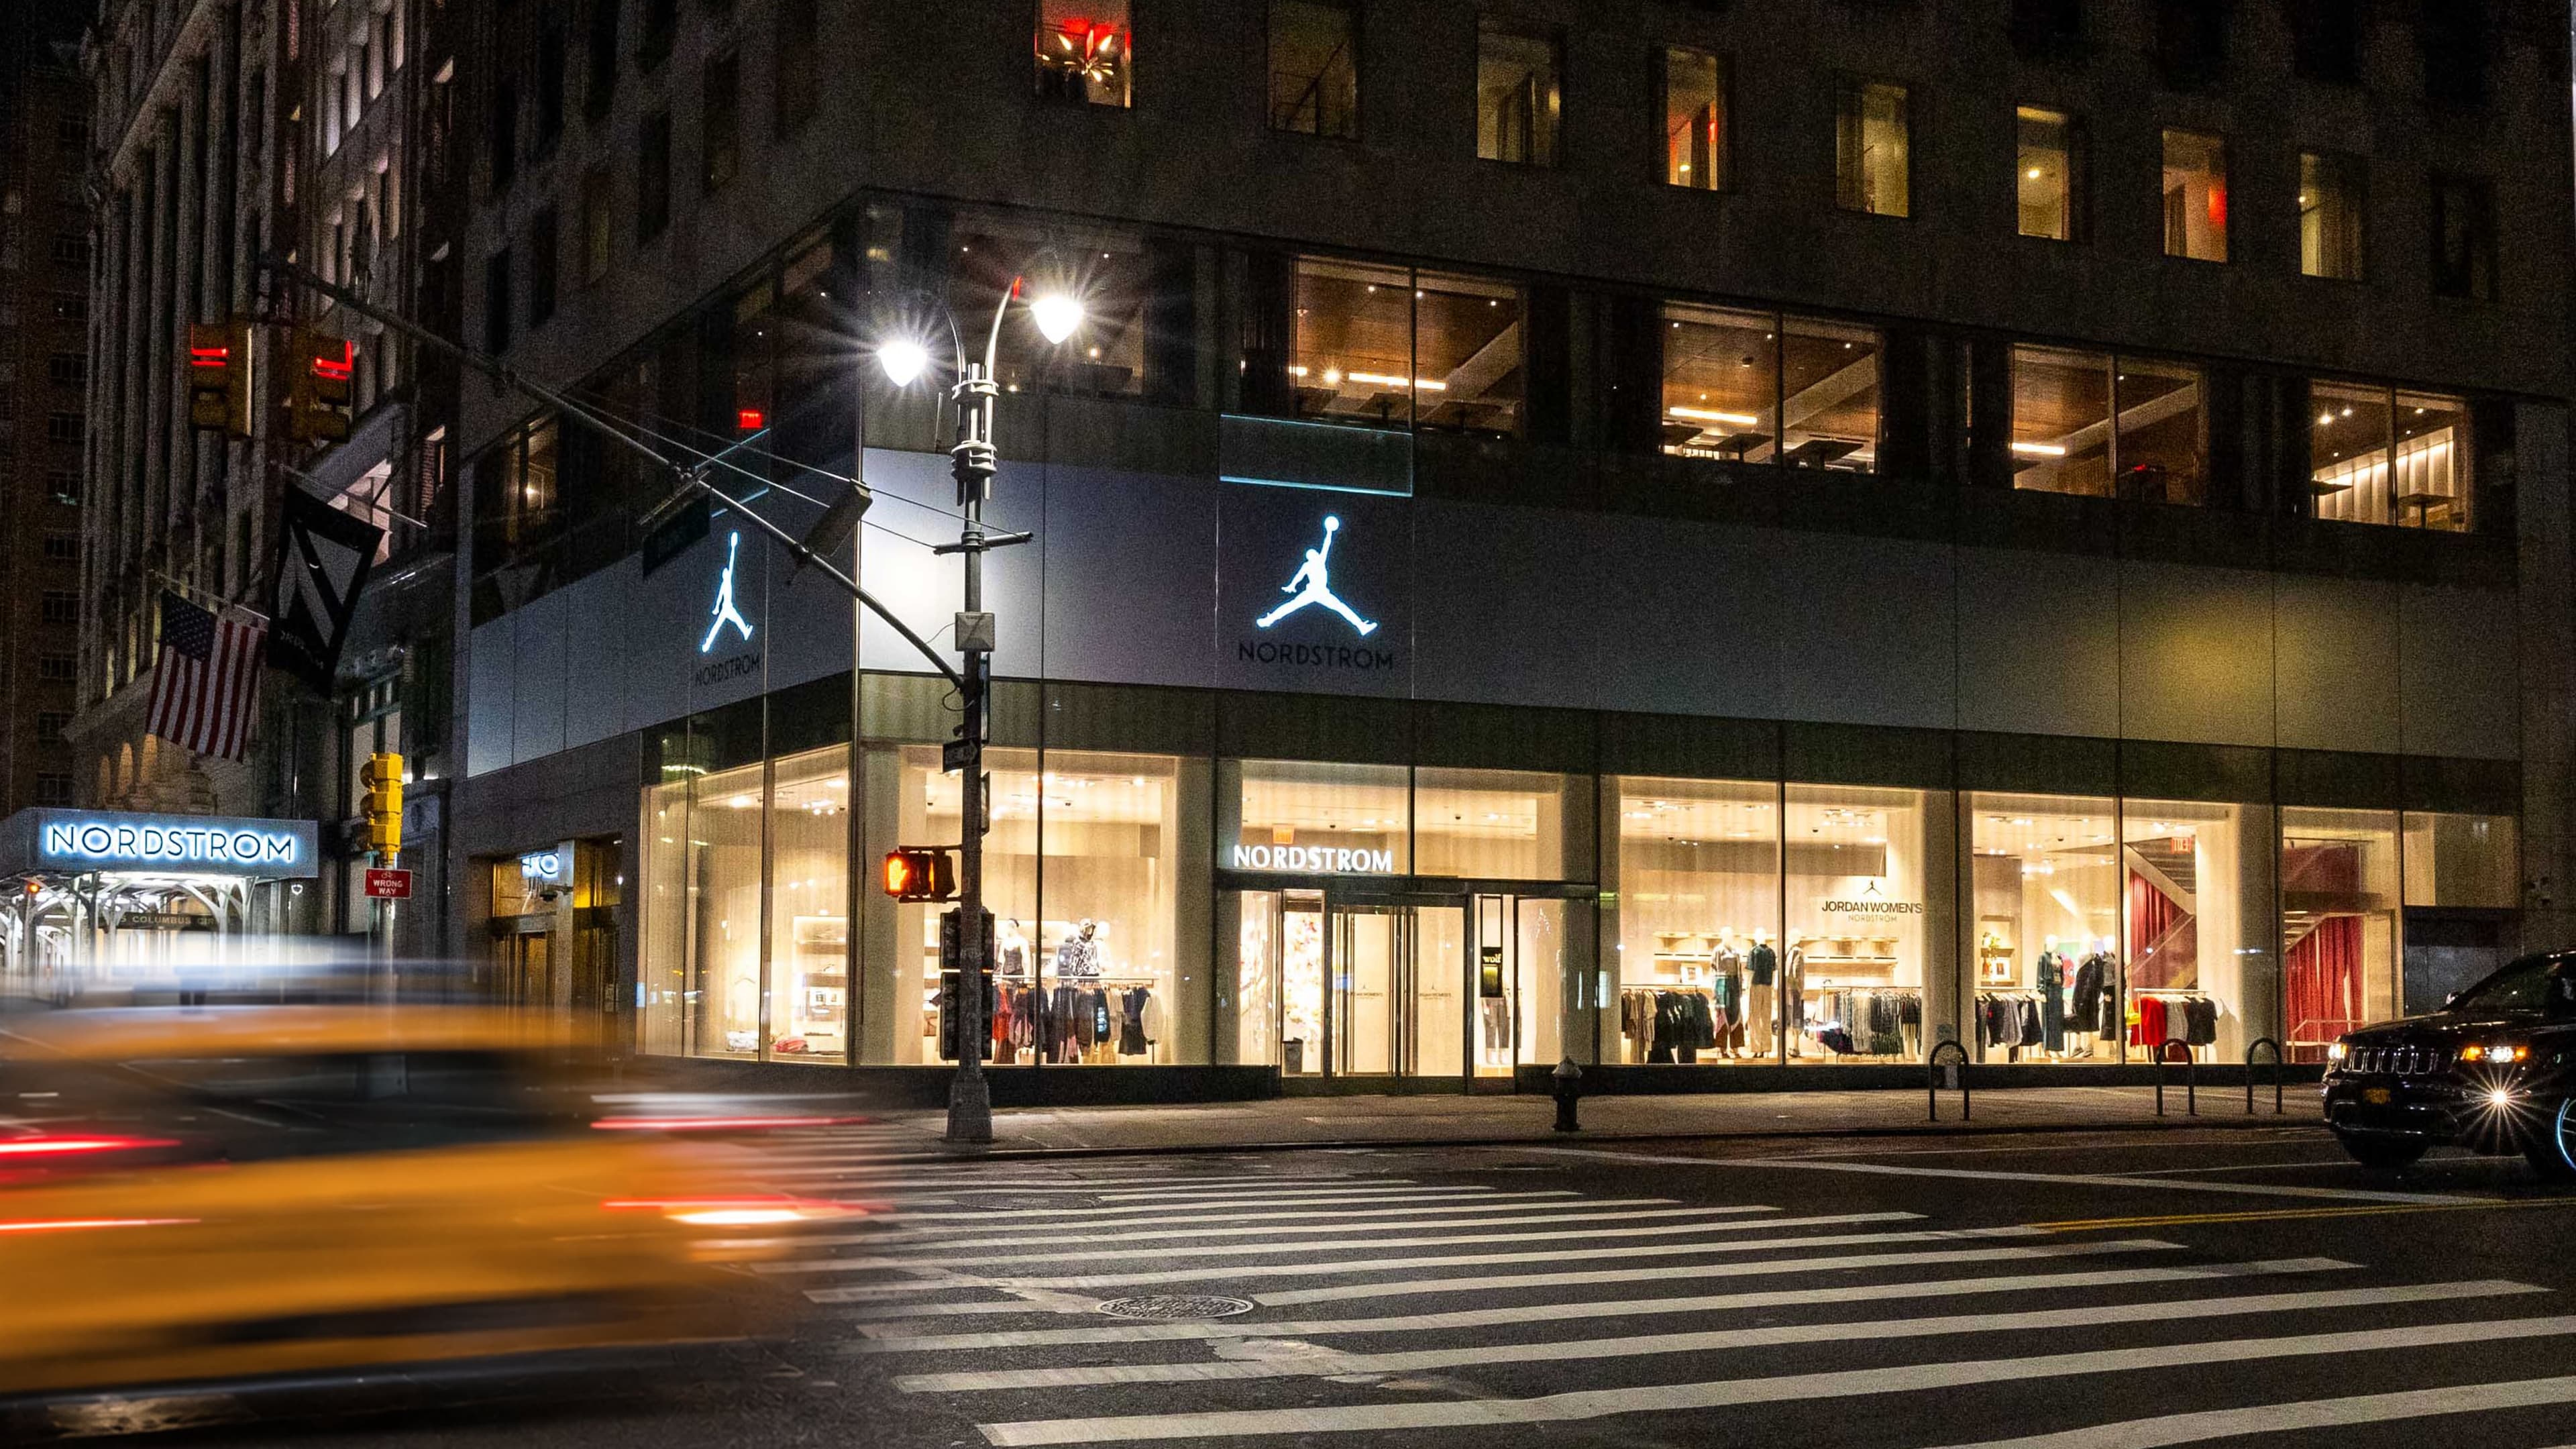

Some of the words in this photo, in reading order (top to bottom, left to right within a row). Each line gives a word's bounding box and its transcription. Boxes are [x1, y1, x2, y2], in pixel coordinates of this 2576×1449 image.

[1238, 642, 1393, 669] NORDSTROM
[695, 653, 760, 687] NORDSTROM
[51, 826, 292, 861] NORDSTROM
[1234, 845, 1393, 872] NORDSTROM
[373, 879, 403, 888] WRONG
[378, 887, 396, 895] WAY
[1821, 901, 1868, 912] JORDAN
[1870, 902, 1922, 913] WOMEN'S
[132, 915, 191, 924] COLUMBUS
[1848, 914, 1897, 922] NORDSTROM
